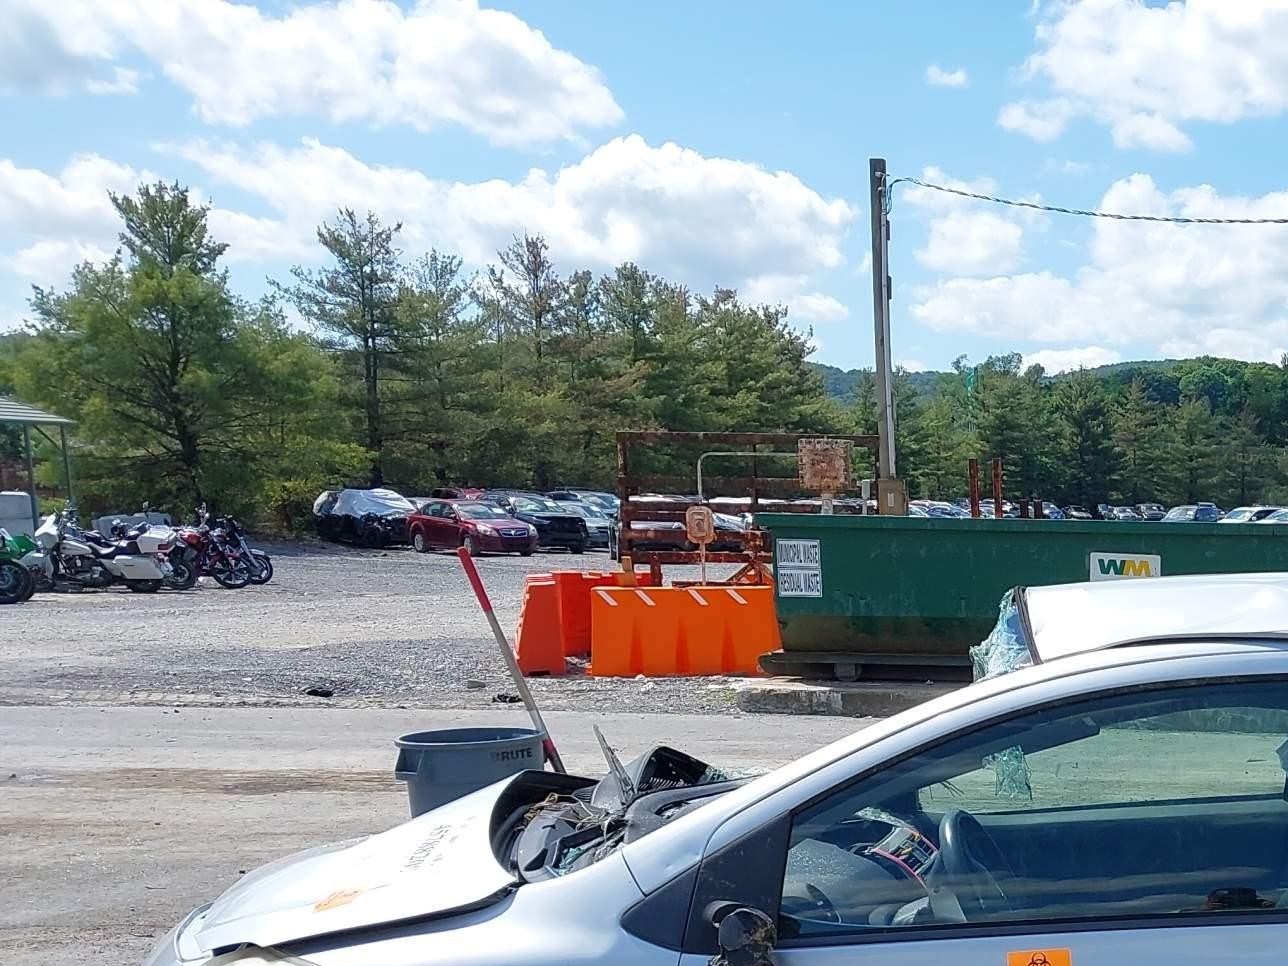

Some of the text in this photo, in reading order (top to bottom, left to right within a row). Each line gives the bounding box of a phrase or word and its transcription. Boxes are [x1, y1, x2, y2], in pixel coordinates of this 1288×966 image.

[779, 544, 818, 564] MUNICIPAL WASTE
[1098, 558, 1152, 577] WM
[780, 573, 820, 592] RESIDUAL WASTE
